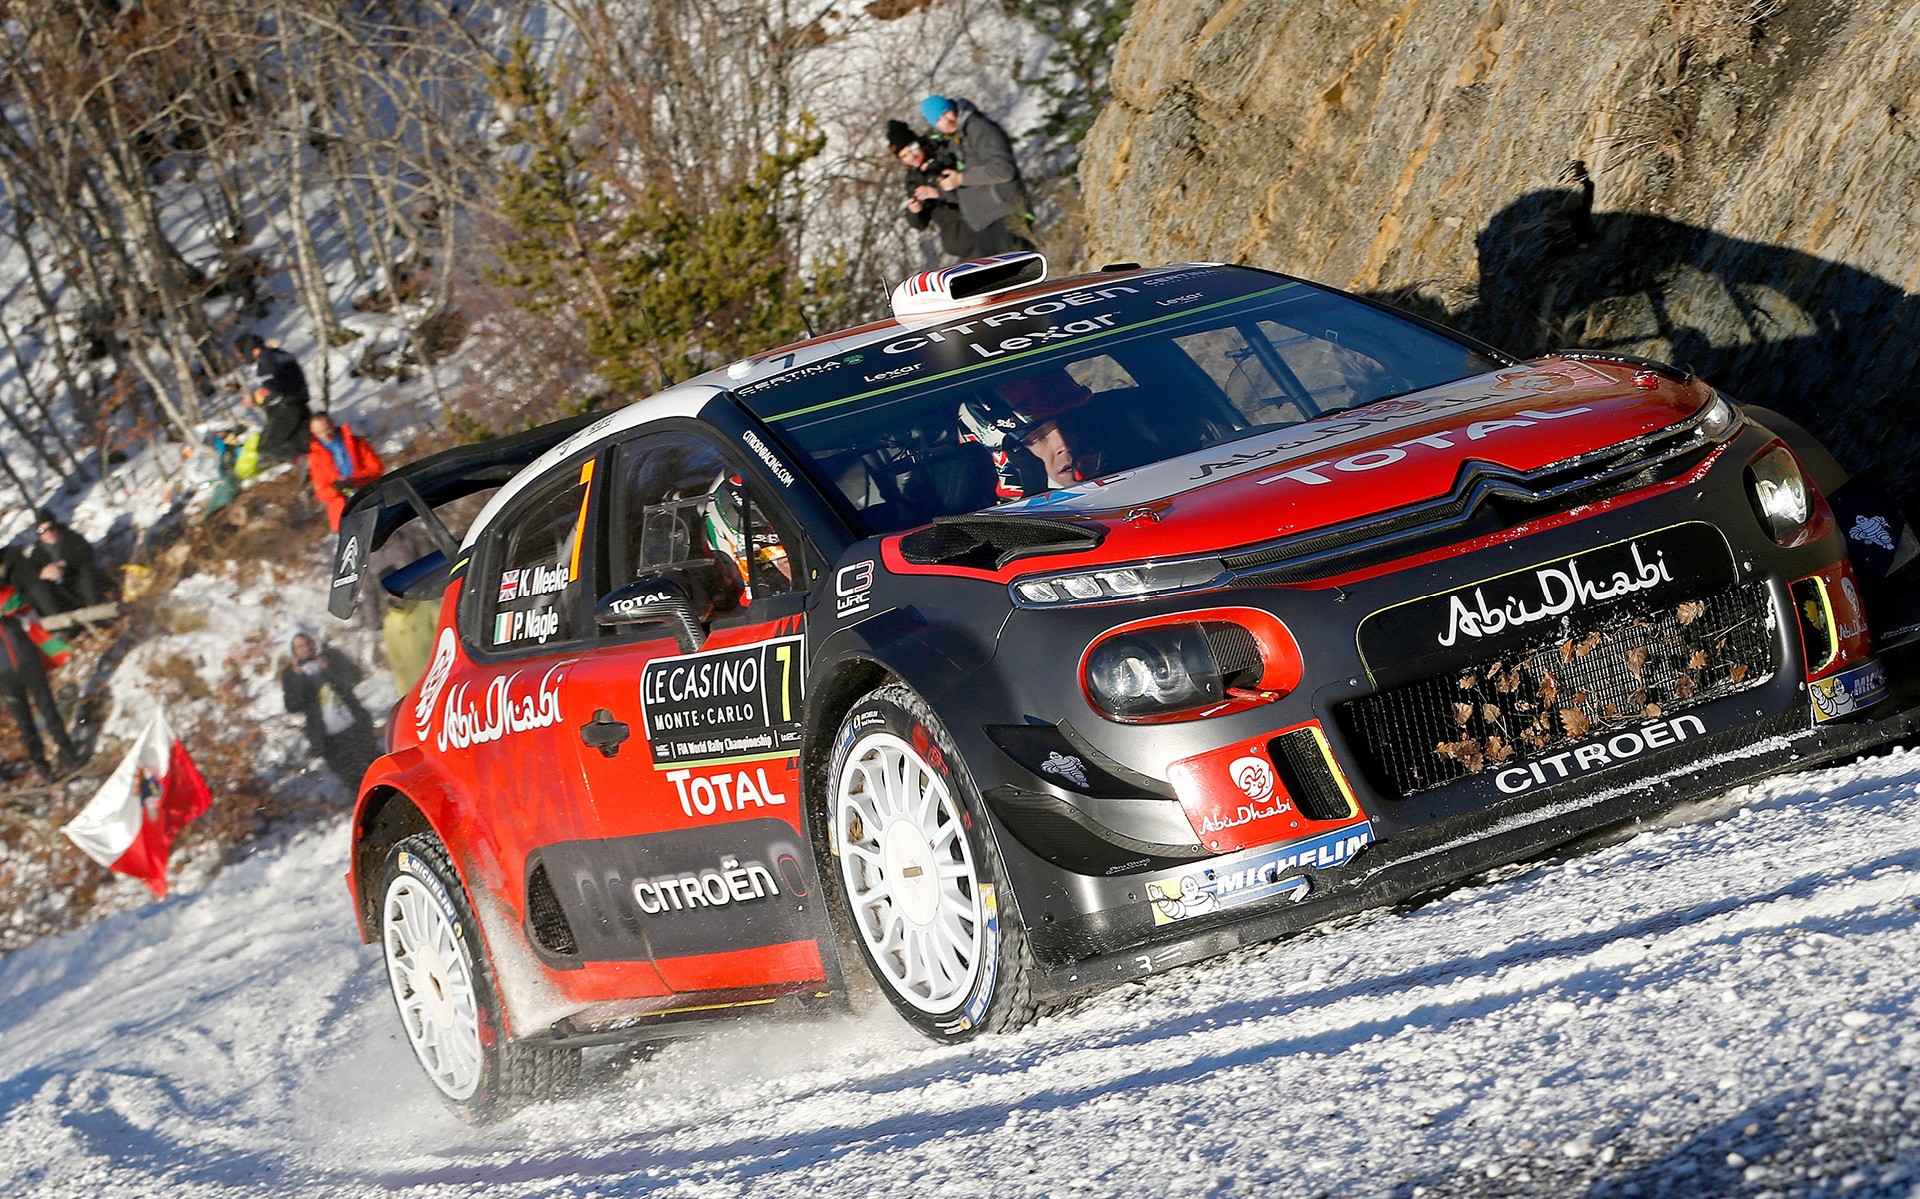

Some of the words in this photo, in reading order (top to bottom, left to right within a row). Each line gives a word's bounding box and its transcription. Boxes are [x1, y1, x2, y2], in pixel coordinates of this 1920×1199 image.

[970, 311, 1117, 358] Lexar
[738, 360, 842, 396] CERTINA
[863, 362, 924, 383] Lexar
[742, 429, 795, 488] CITROENRACING.COM
[1256, 406, 1593, 486] TOTAL
[517, 567, 532, 598] K.
[531, 561, 570, 596] Meeke
[836, 559, 875, 597] C3
[609, 592, 672, 614] TOTAL
[837, 590, 871, 611] WRC
[512, 611, 524, 641] P.
[523, 605, 559, 644] Nagle
[645, 669, 668, 705] LE
[668, 657, 758, 703] CASINO
[775, 645, 792, 722] 7
[676, 742, 690, 756] FIA
[689, 741, 708, 755] World
[707, 738, 725, 754] Rally
[724, 734, 773, 751] Championship
[666, 766, 787, 817] TOTAL
[410, 858, 456, 919] MICHELIN
